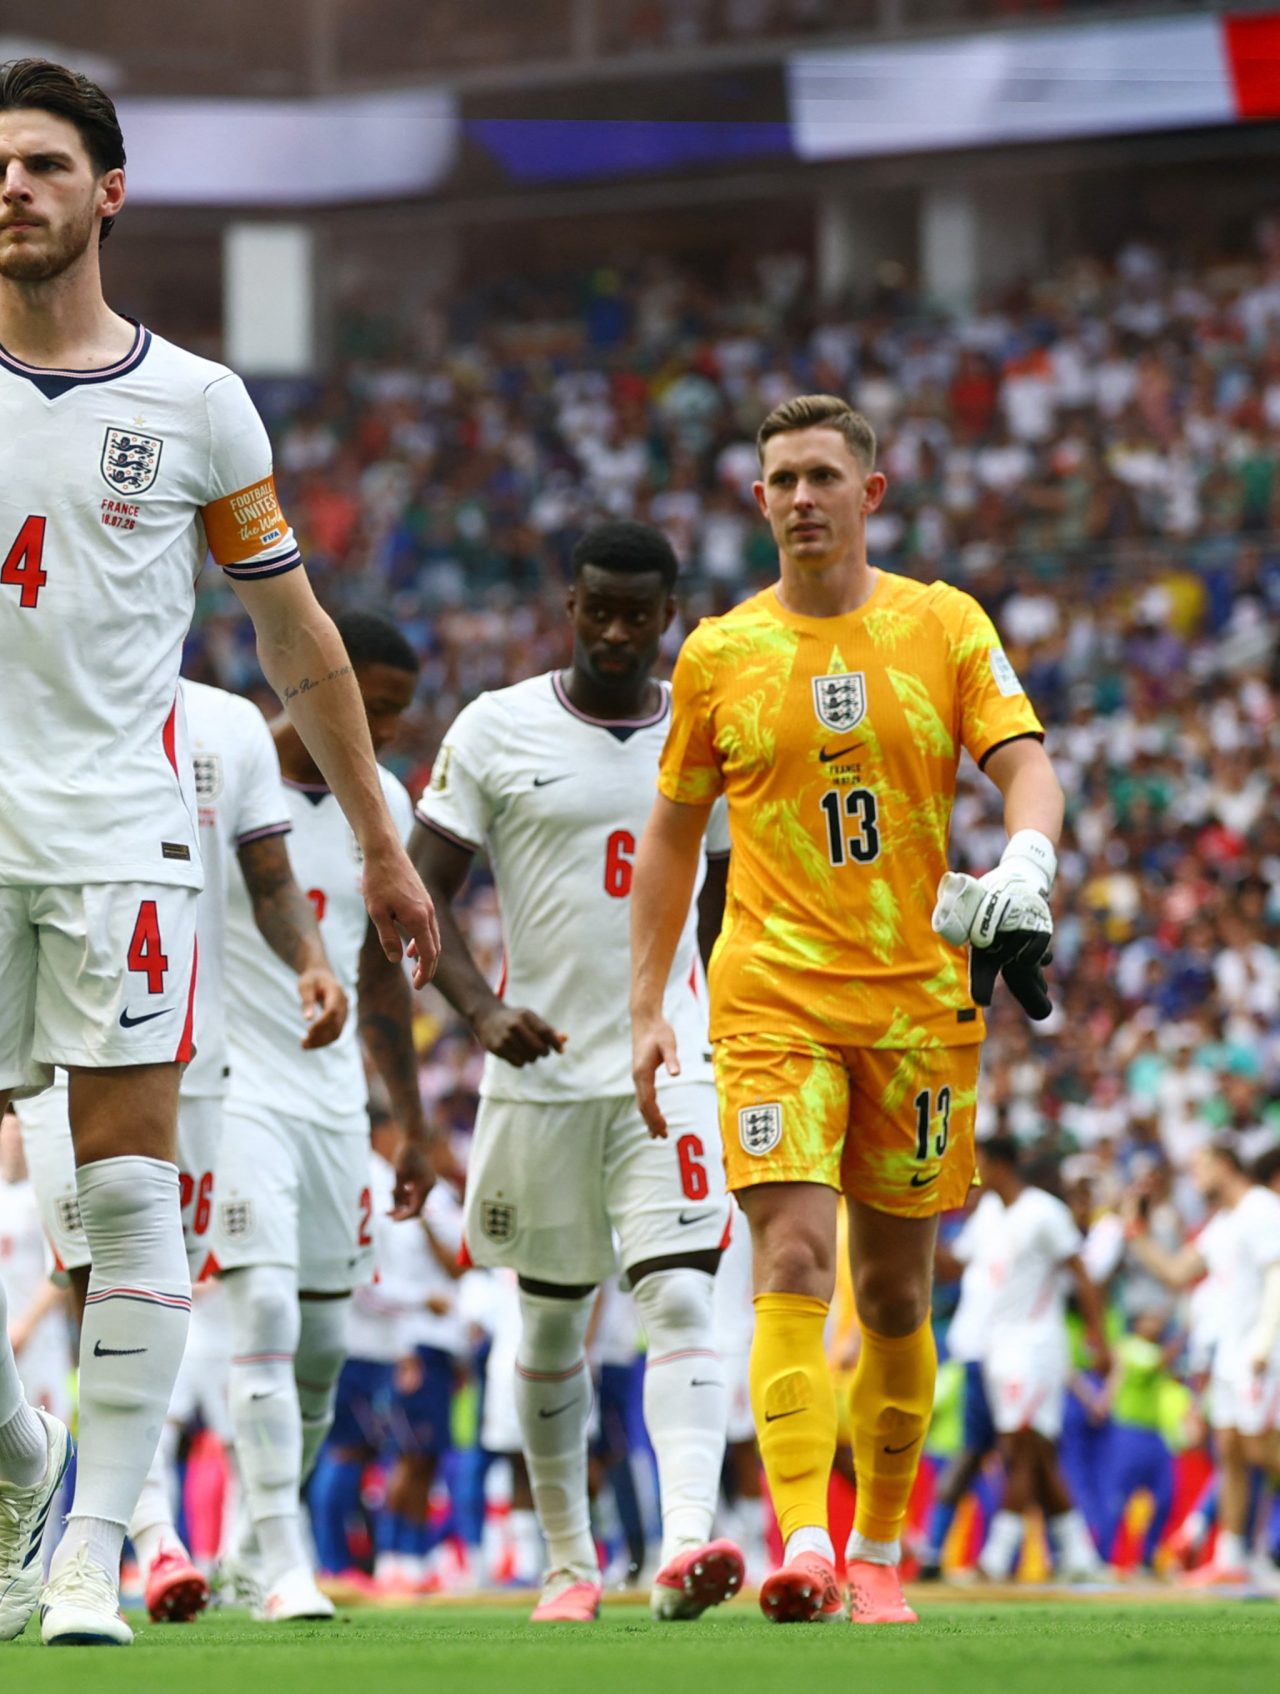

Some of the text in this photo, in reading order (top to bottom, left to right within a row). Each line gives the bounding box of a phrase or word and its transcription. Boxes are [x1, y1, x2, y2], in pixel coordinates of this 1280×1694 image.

[101, 499, 140, 517] FRANCE
[102, 513, 135, 530] 18.07.26
[230, 482, 272, 510] FOOTBALL
[234, 493, 277, 525] UNITES
[238, 524, 259, 541] the
[262, 530, 280, 543] FIFA
[0, 514, 48, 609] 4
[820, 788, 880, 867] 13
[602, 829, 634, 899] 6
[979, 887, 1000, 938] reusch
[914, 1085, 951, 1161] 13
[675, 1133, 710, 1202] 6
[357, 1187, 373, 1247] 2
